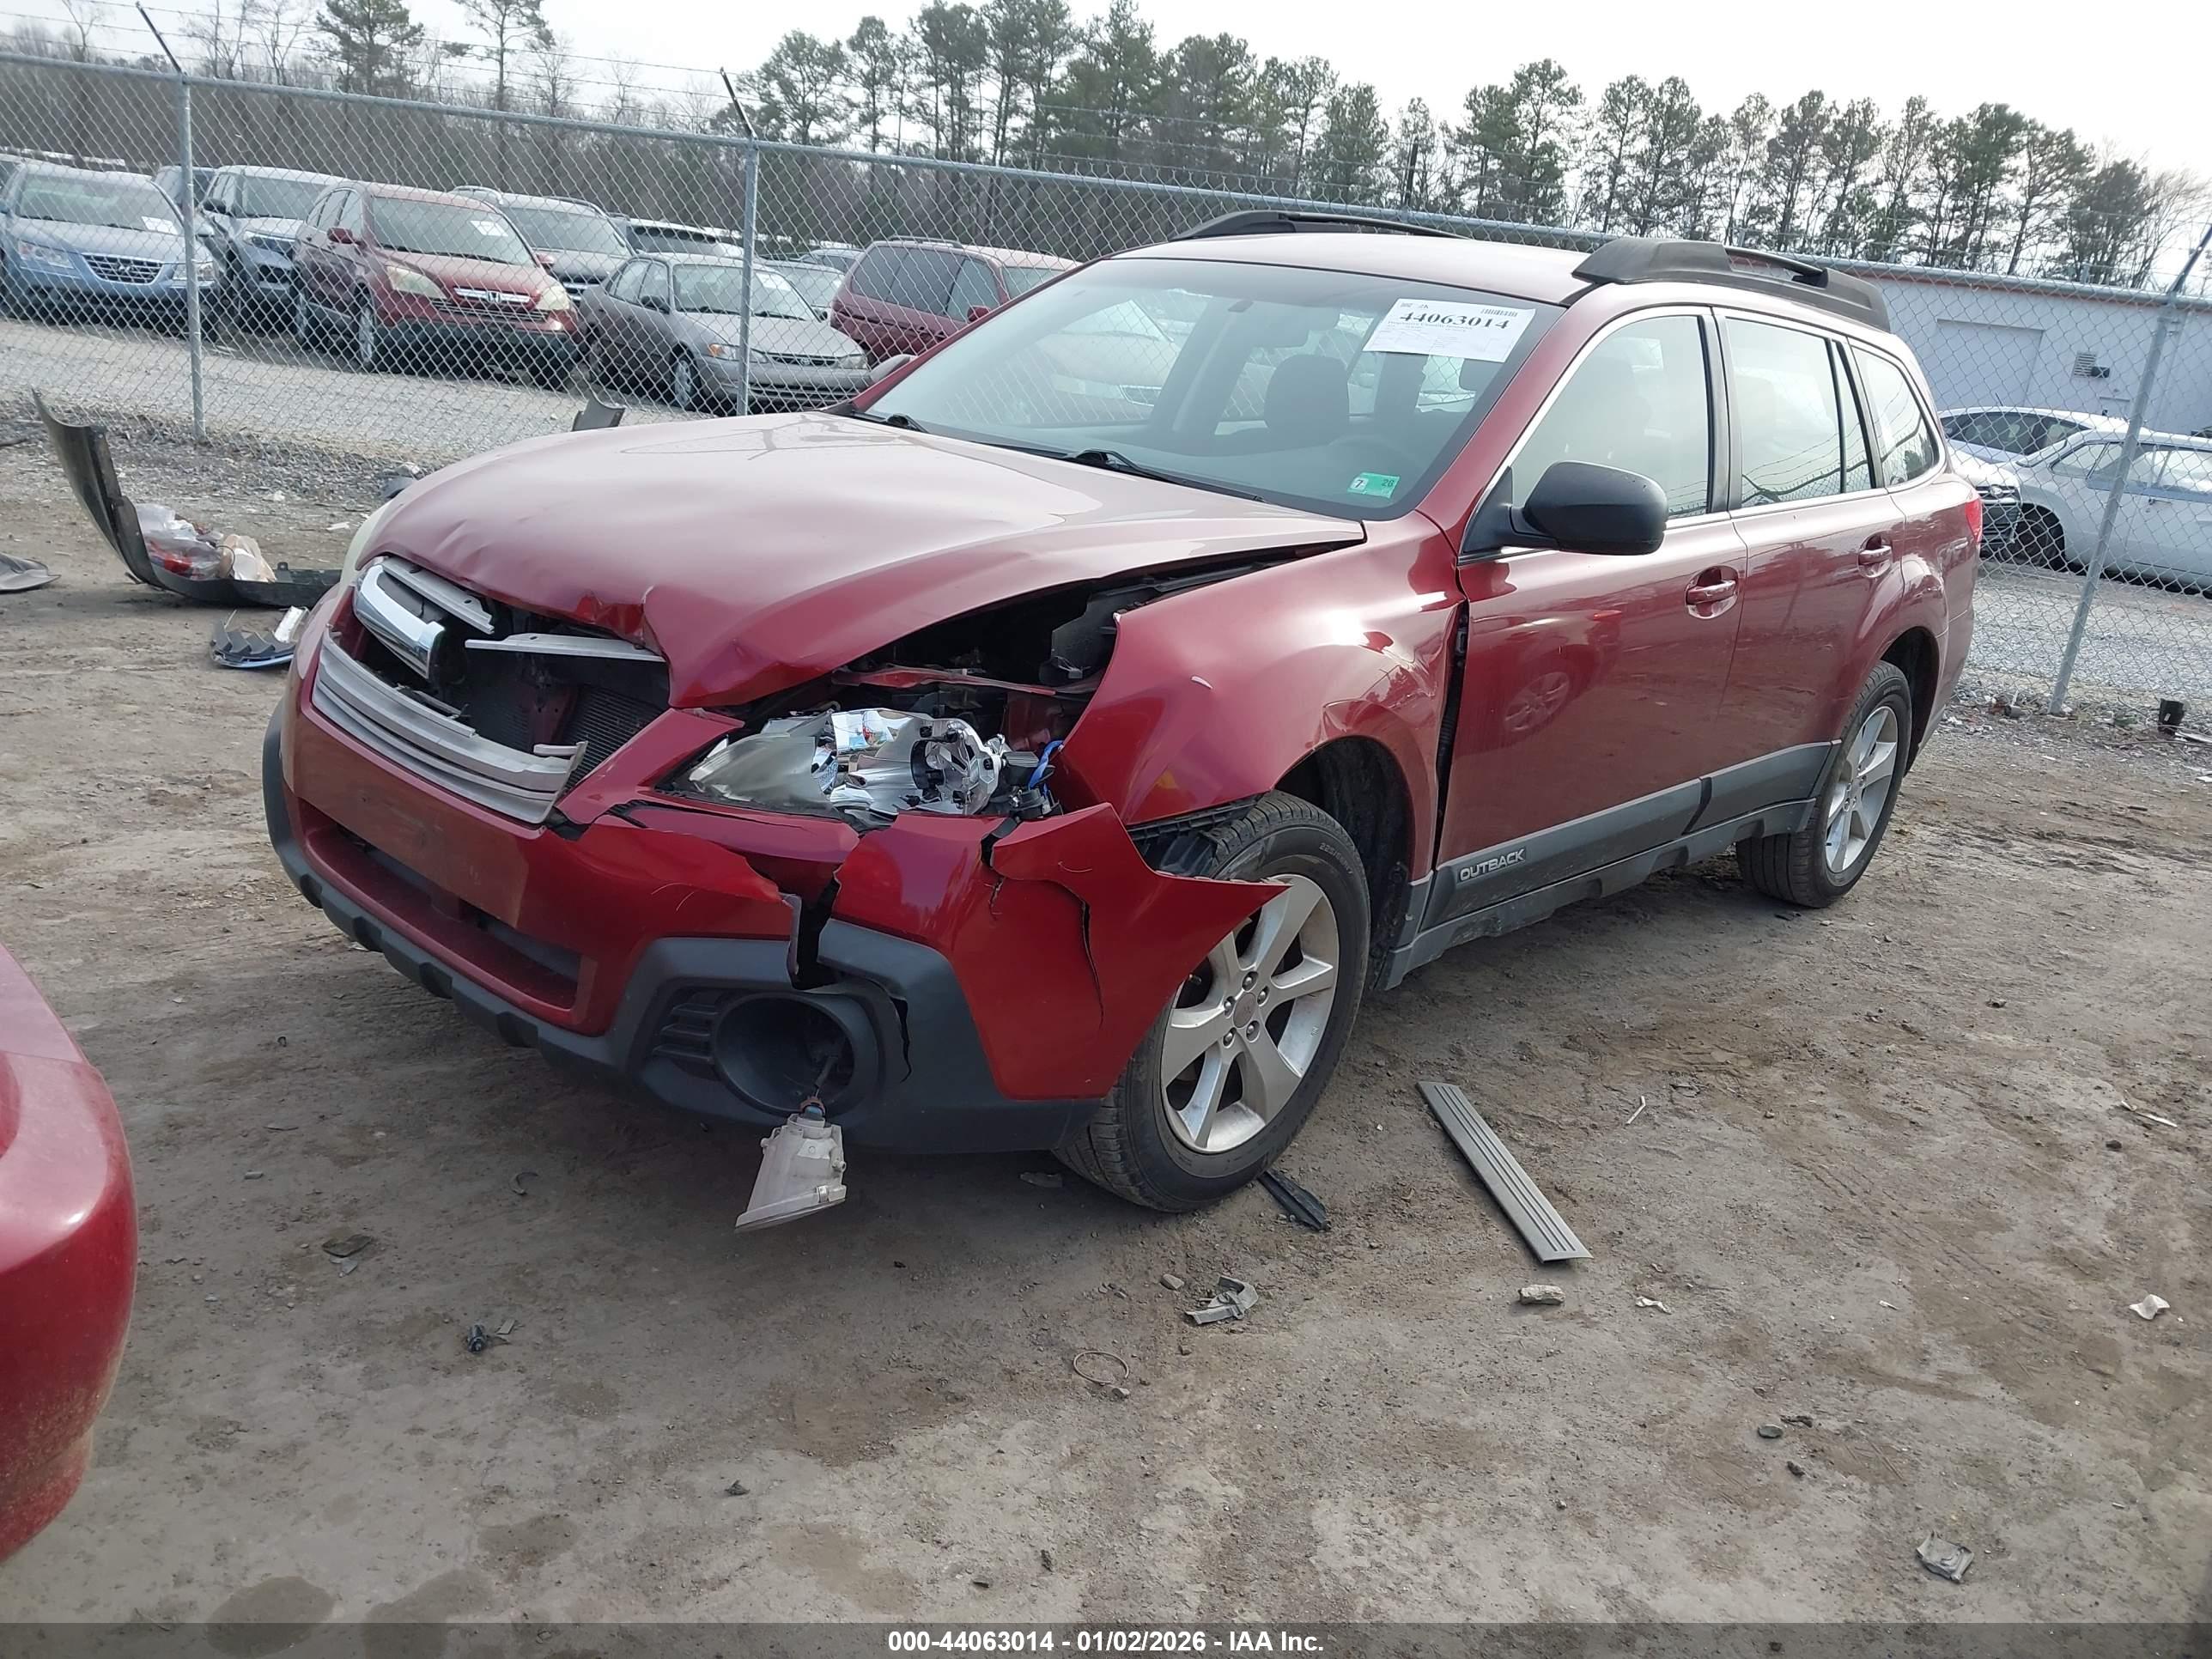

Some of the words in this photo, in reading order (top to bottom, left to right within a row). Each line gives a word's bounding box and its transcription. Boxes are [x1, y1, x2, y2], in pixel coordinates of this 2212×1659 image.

[1400, 311, 1510, 329] 44063014
[1355, 479, 1364, 489] 7
[1460, 848, 1524, 881] OUTBACK
